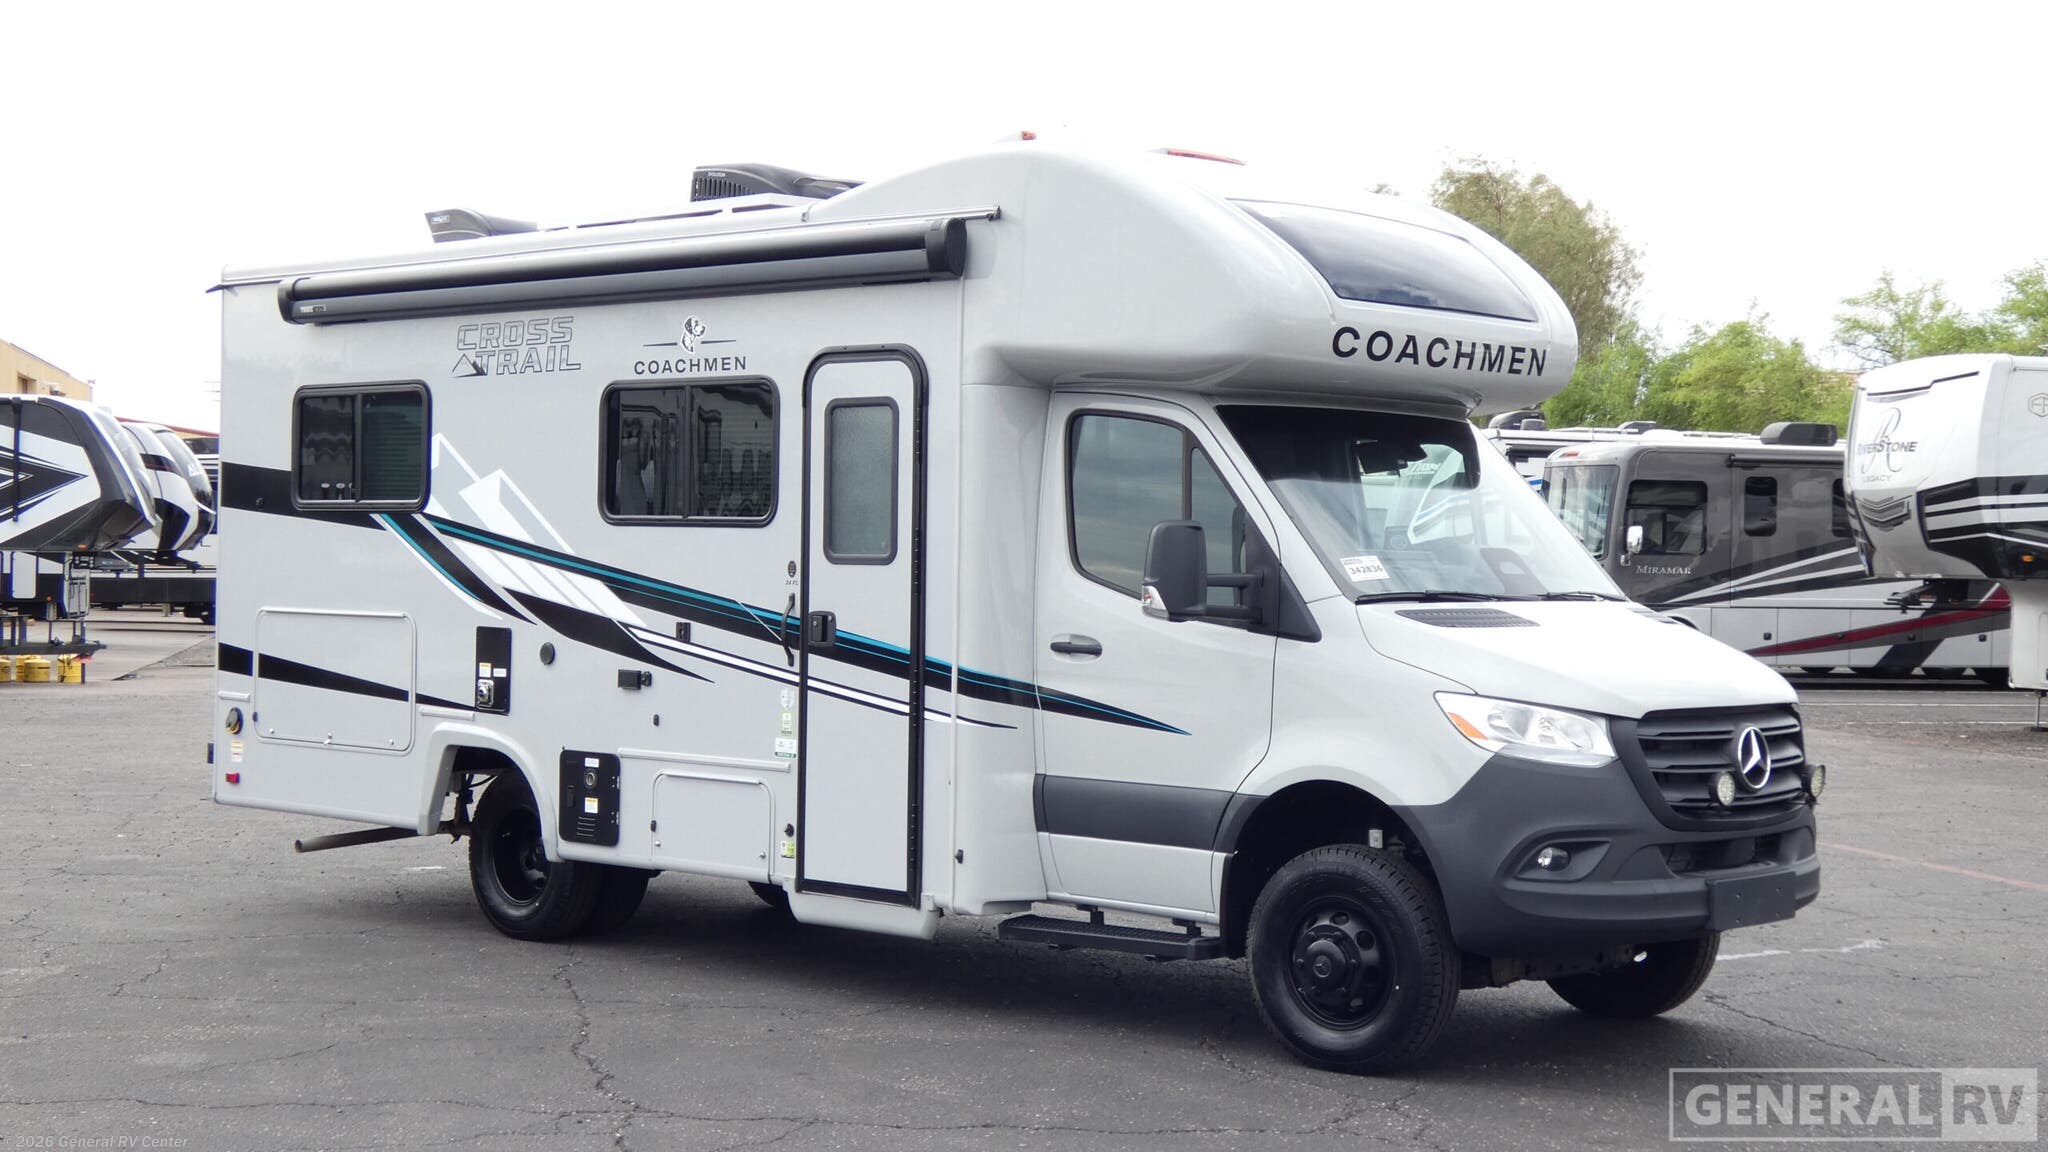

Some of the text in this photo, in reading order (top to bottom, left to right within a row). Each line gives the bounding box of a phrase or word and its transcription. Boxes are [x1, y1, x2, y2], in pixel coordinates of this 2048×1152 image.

[457, 316, 574, 350] CROSS
[475, 345, 581, 376] TRAIL
[634, 356, 746, 375] COACHMEN
[1332, 326, 1547, 377] COACHMEN
[1636, 565, 1692, 575] MIRAMAR
